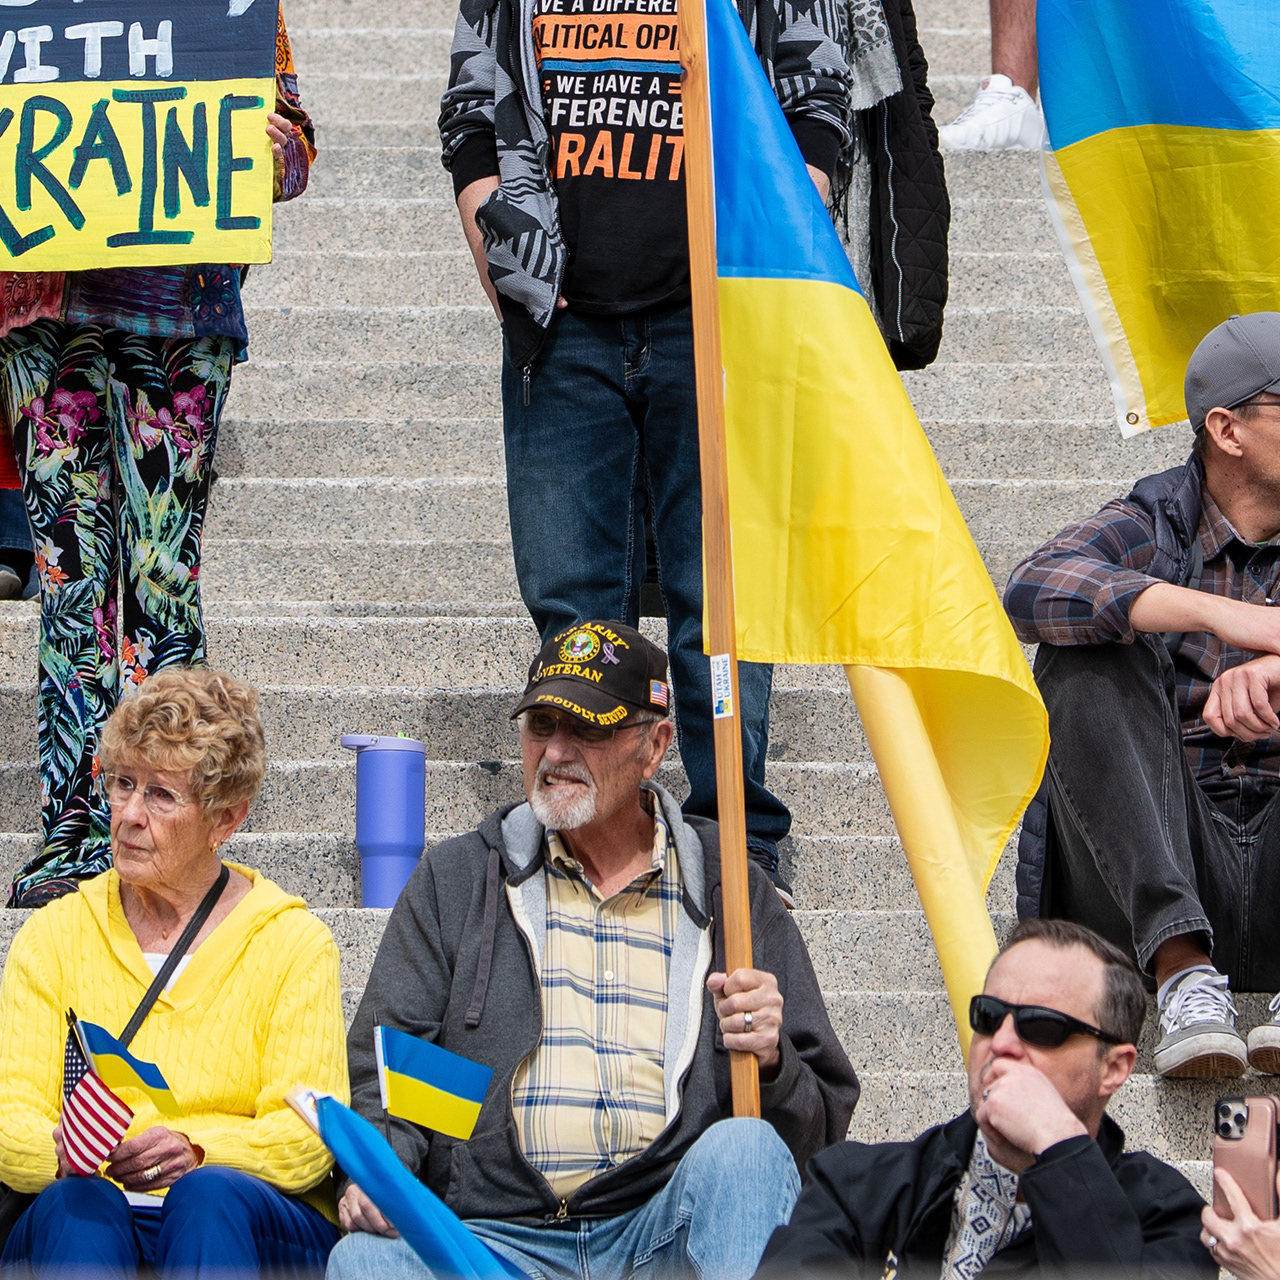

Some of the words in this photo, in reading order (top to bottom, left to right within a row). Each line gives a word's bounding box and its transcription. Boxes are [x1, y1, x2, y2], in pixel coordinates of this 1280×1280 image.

[556, 75, 587, 95] WE
[592, 74, 643, 95] HAVE
[648, 76, 661, 95] A
[580, 622, 630, 650] ARMY
[542, 663, 604, 683] VETERAN
[716, 673, 724, 700] UTAH
[722, 657, 730, 698] UKRAINE
[535, 694, 596, 723] PROUDLY
[596, 705, 628, 726] SERVED
